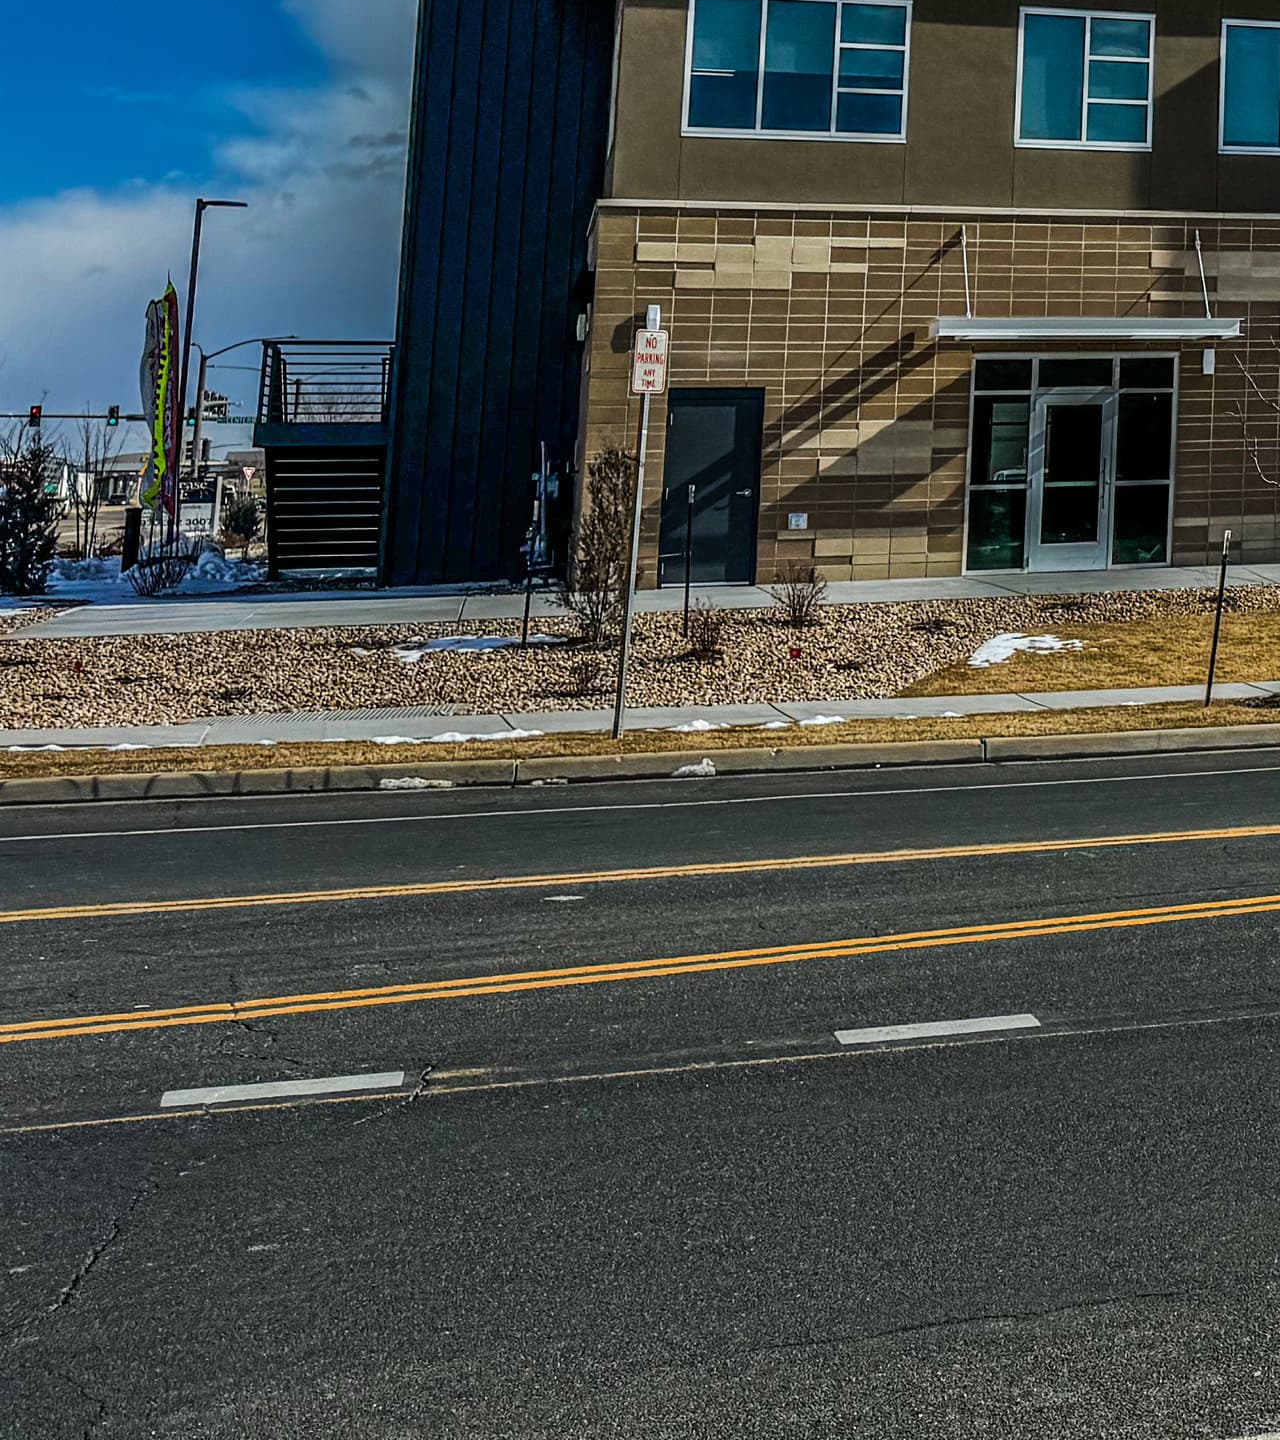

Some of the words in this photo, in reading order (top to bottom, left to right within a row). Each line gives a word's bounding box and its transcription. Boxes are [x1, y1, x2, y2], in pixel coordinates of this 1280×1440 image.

[645, 337, 657, 349] NO
[636, 353, 664, 365] PARKING
[643, 369, 656, 377] ANY
[641, 379, 655, 388] TIME
